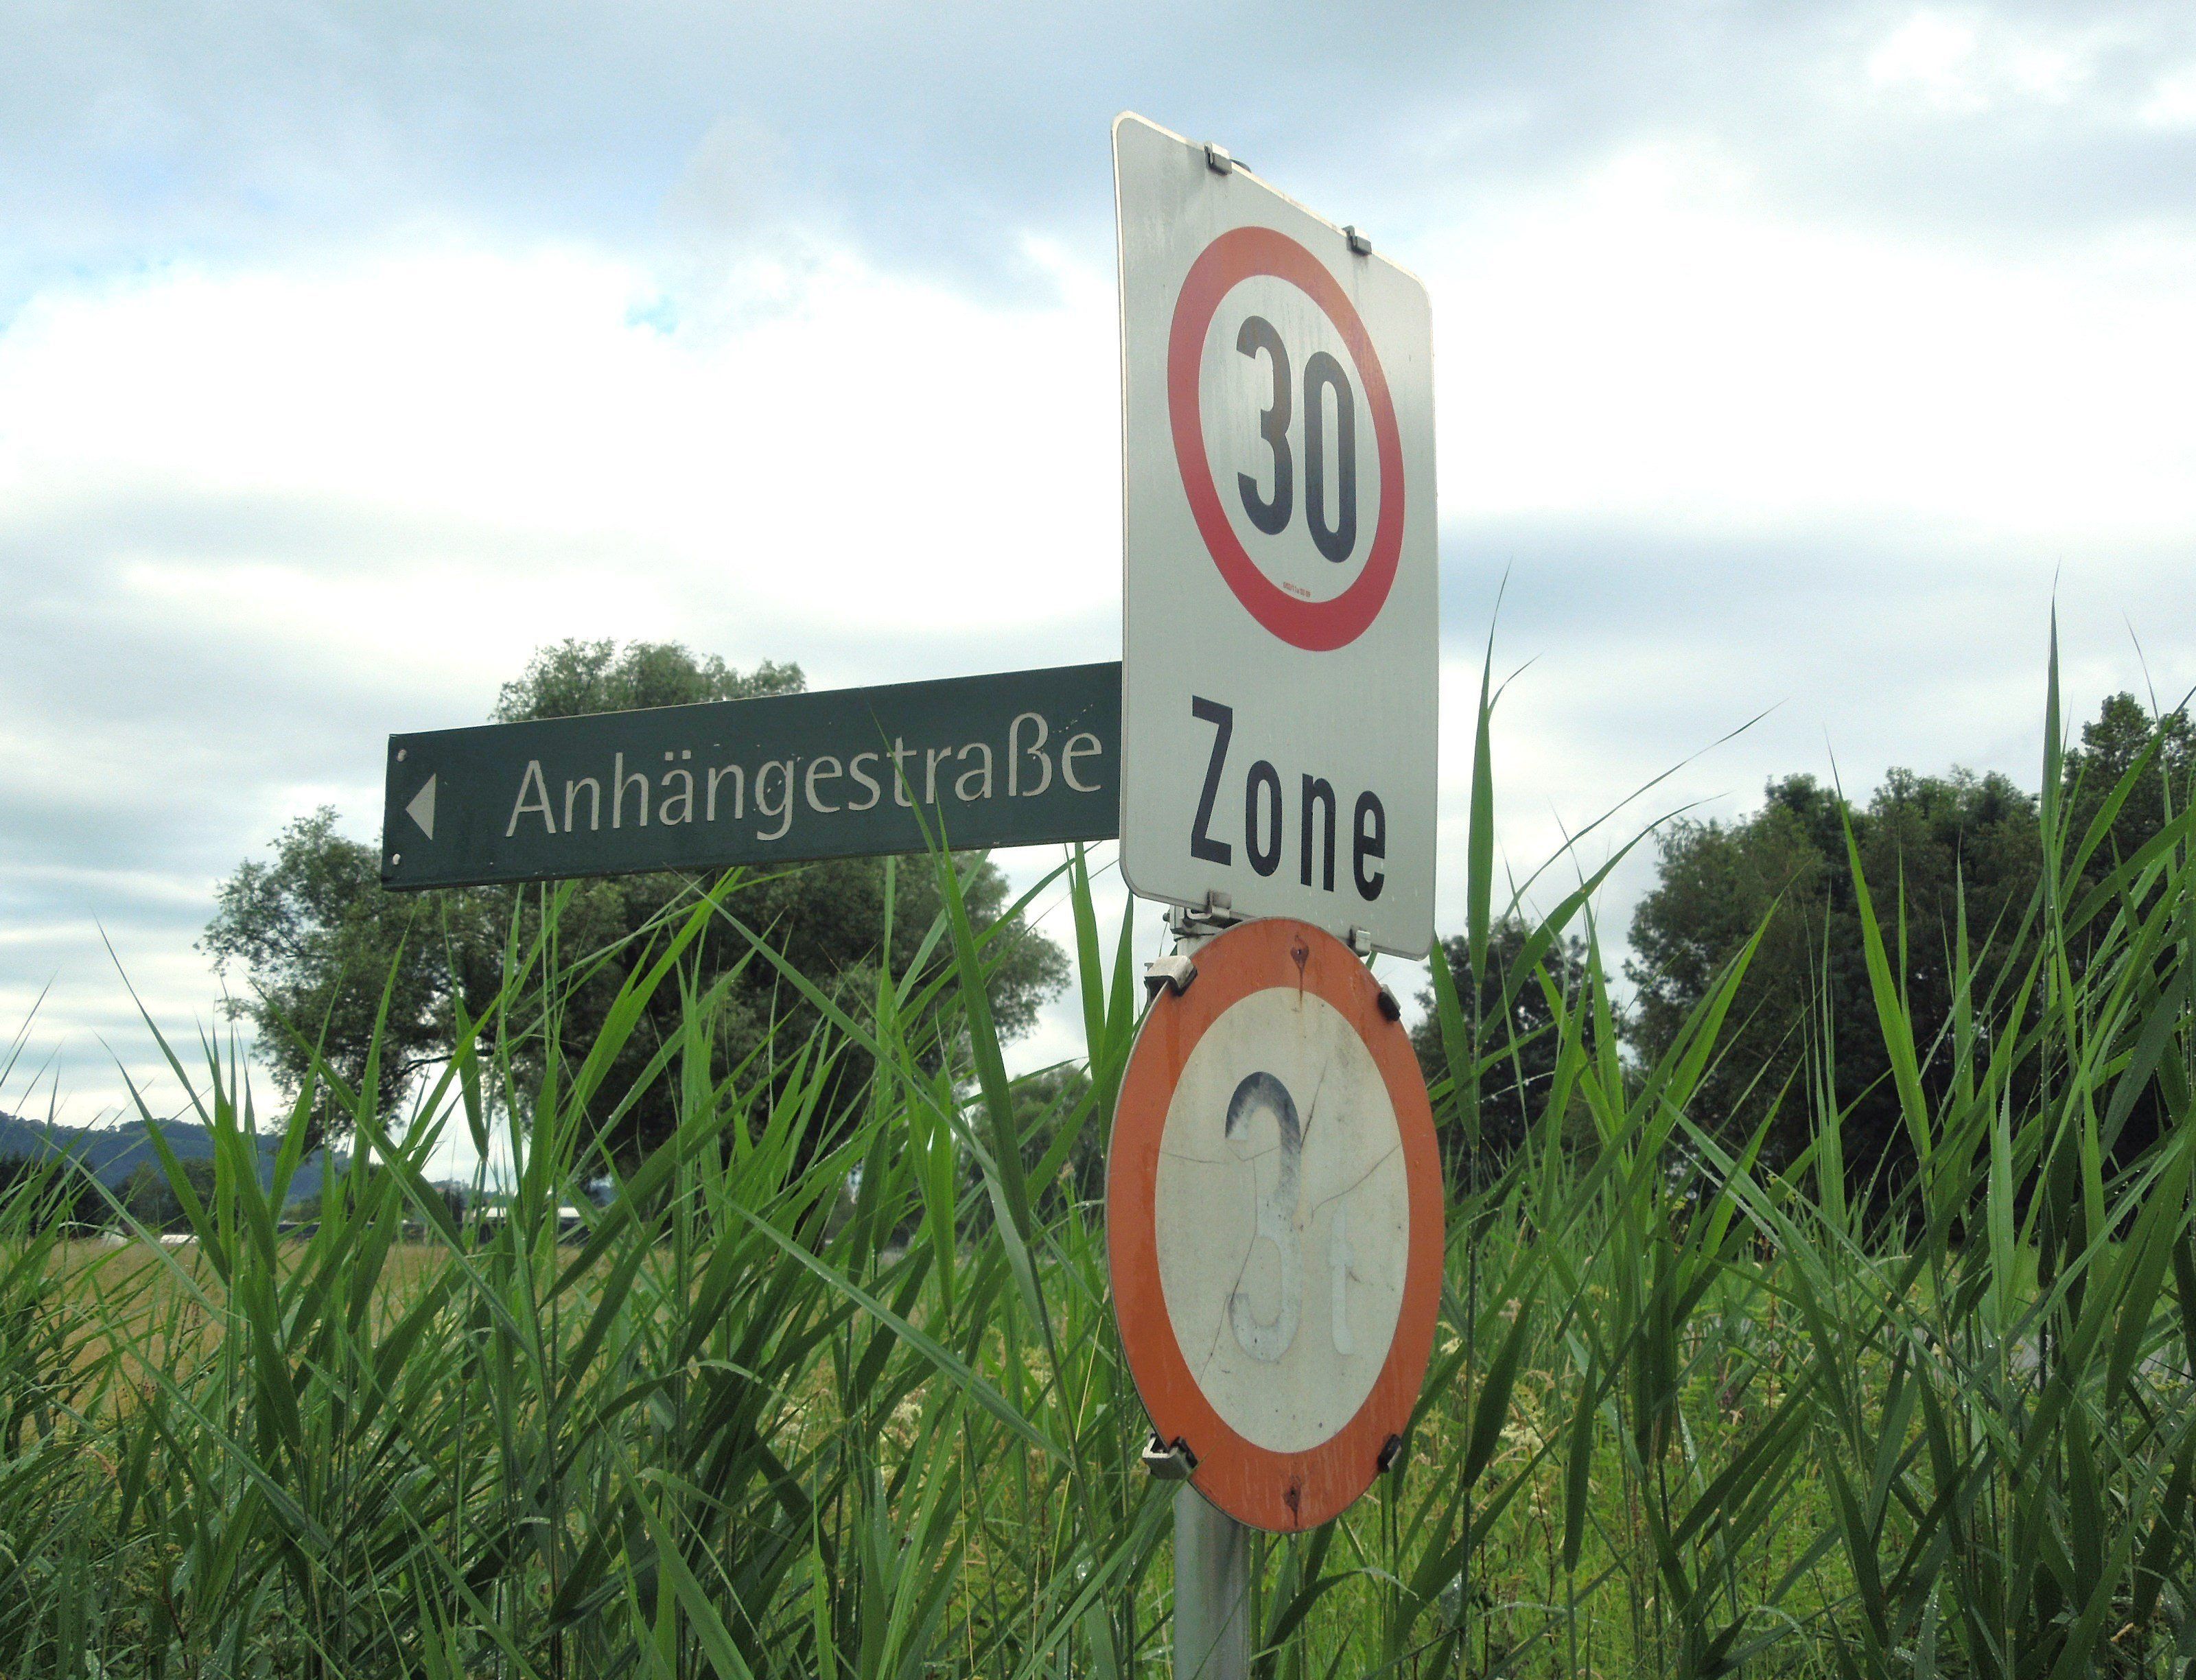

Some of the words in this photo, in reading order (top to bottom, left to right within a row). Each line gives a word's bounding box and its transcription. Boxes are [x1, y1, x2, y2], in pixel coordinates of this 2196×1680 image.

[1236, 315, 1357, 563] 30
[506, 712, 1103, 841] Anhängestraße
[1191, 695, 1386, 901] Zone
